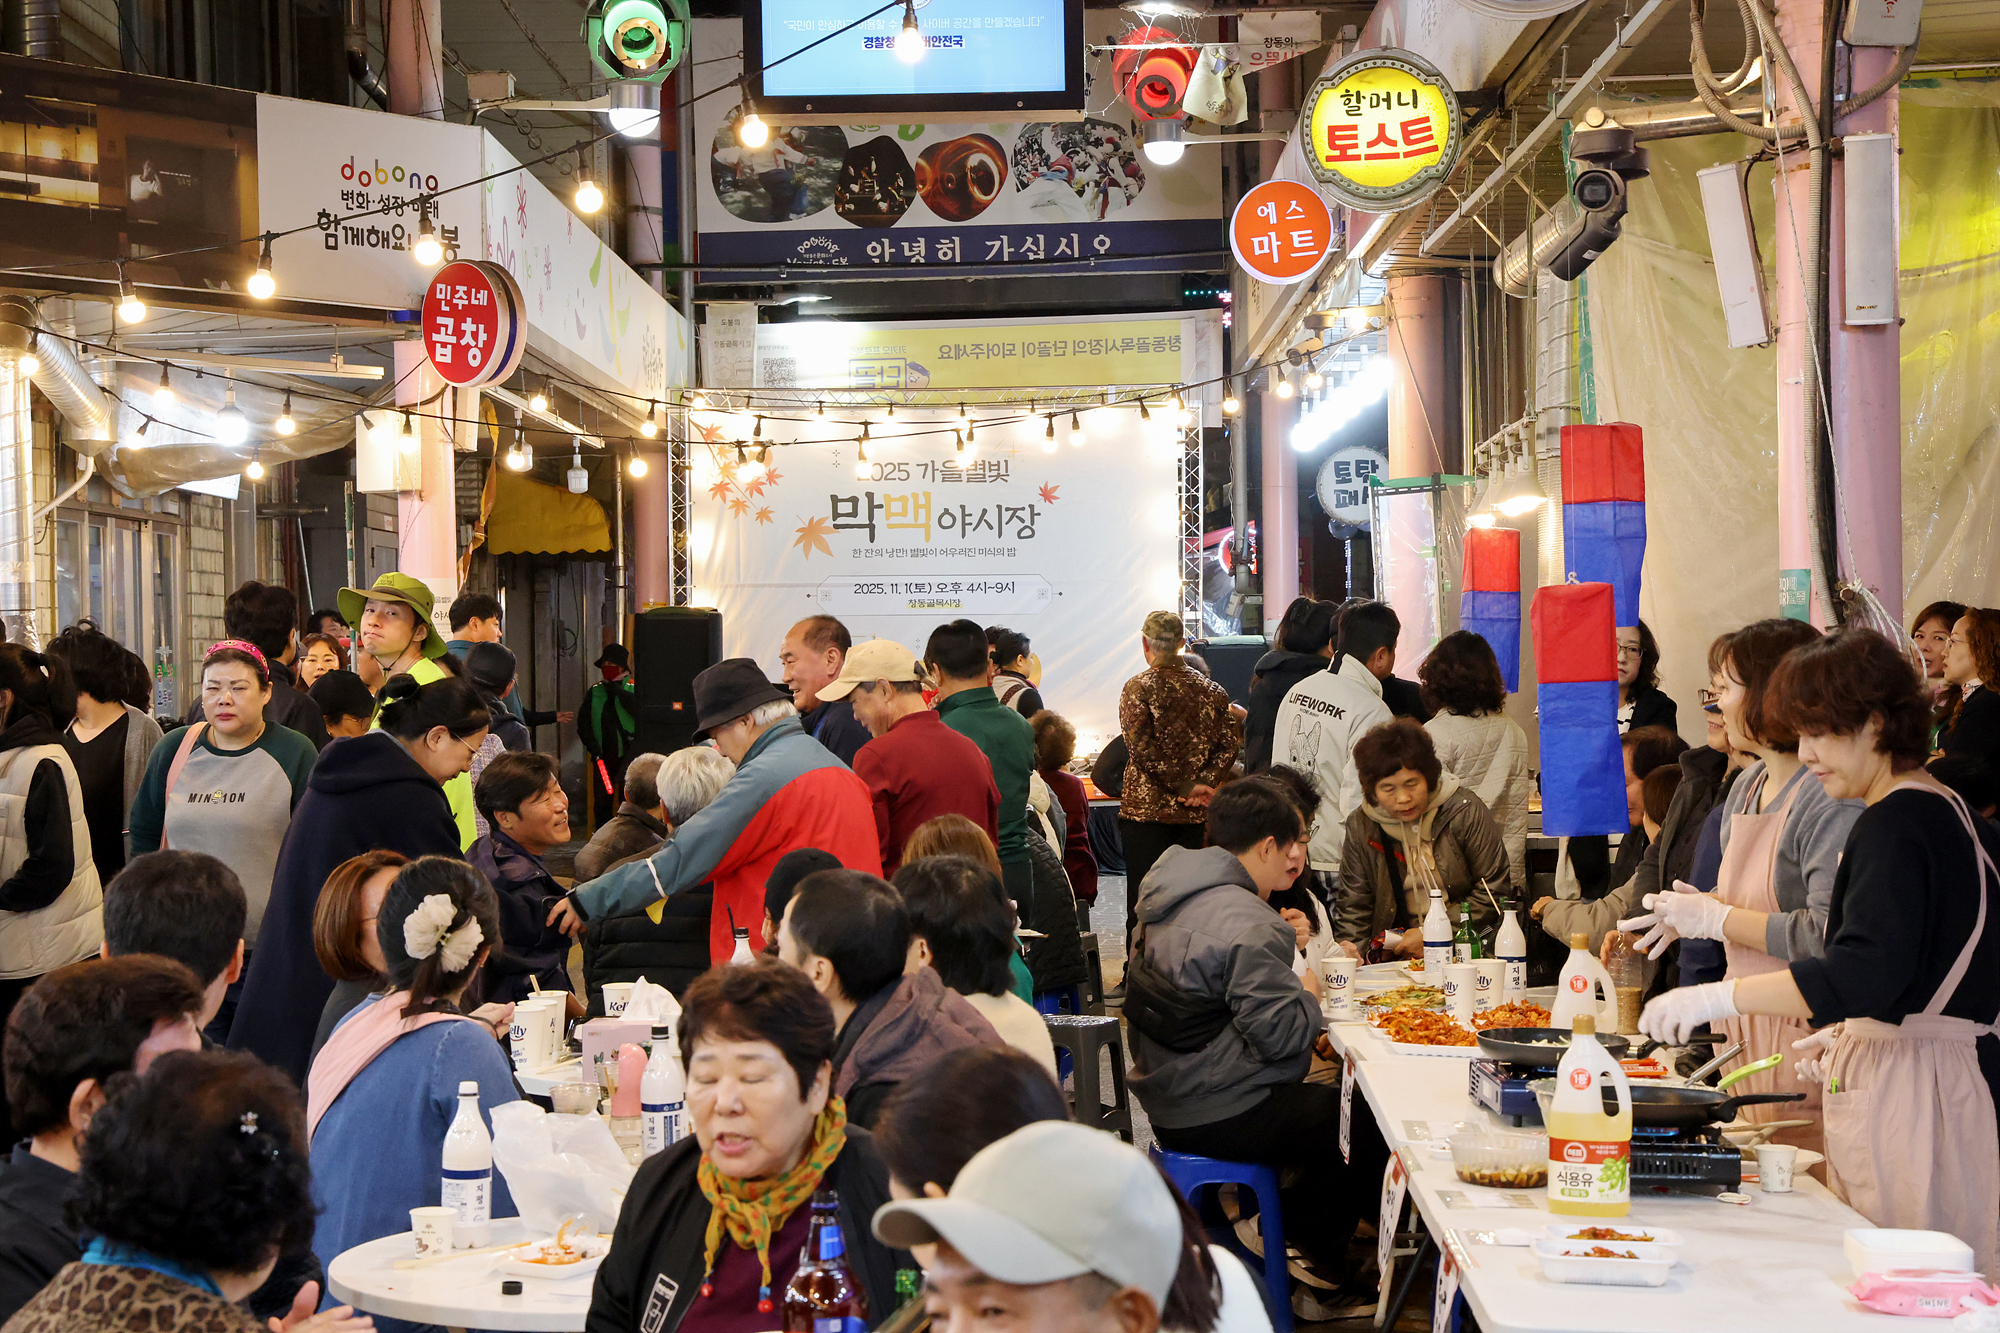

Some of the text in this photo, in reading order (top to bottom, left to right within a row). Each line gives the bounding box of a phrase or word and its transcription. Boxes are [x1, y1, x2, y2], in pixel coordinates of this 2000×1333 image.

[922, 17, 950, 29] 사이버
[953, 17, 982, 29] 공간을
[863, 36, 896, 49] 경찰청
[1263, 36, 1294, 49] 창동의
[1340, 89, 1418, 117] 할머니
[1325, 115, 1439, 162] 토스트
[341, 155, 439, 192] dobong
[1257, 200, 1306, 225] 에스
[317, 208, 412, 251] 함께해요!
[866, 233, 1111, 264] 안녕히 가십시오
[1250, 229, 1319, 264] 마트
[435, 283, 488, 311] 민주네
[432, 316, 488, 367] 곱창
[916, 459, 1010, 483] 가을별빛
[830, 491, 1041, 543] 막맥 야시장
[852, 547, 1017, 558] 한 잔의 낭만! 별빛이 어우러진 미식의 밤
[853, 581, 1015, 596] 2025. 11. 1(토) 오후 4시~9시
[908, 598, 961, 608] 창동골목시장
[1289, 692, 1346, 720] LIFEWORK
[1325, 974, 1349, 986] Kelly
[1512, 966, 1520, 986] 지평
[1444, 981, 1459, 994] elly
[510, 1025, 527, 1038] elly
[1556, 1171, 1594, 1187] 식용유
[476, 1183, 484, 1205] 지평
[1918, 1298, 1950, 1307] SHINE
